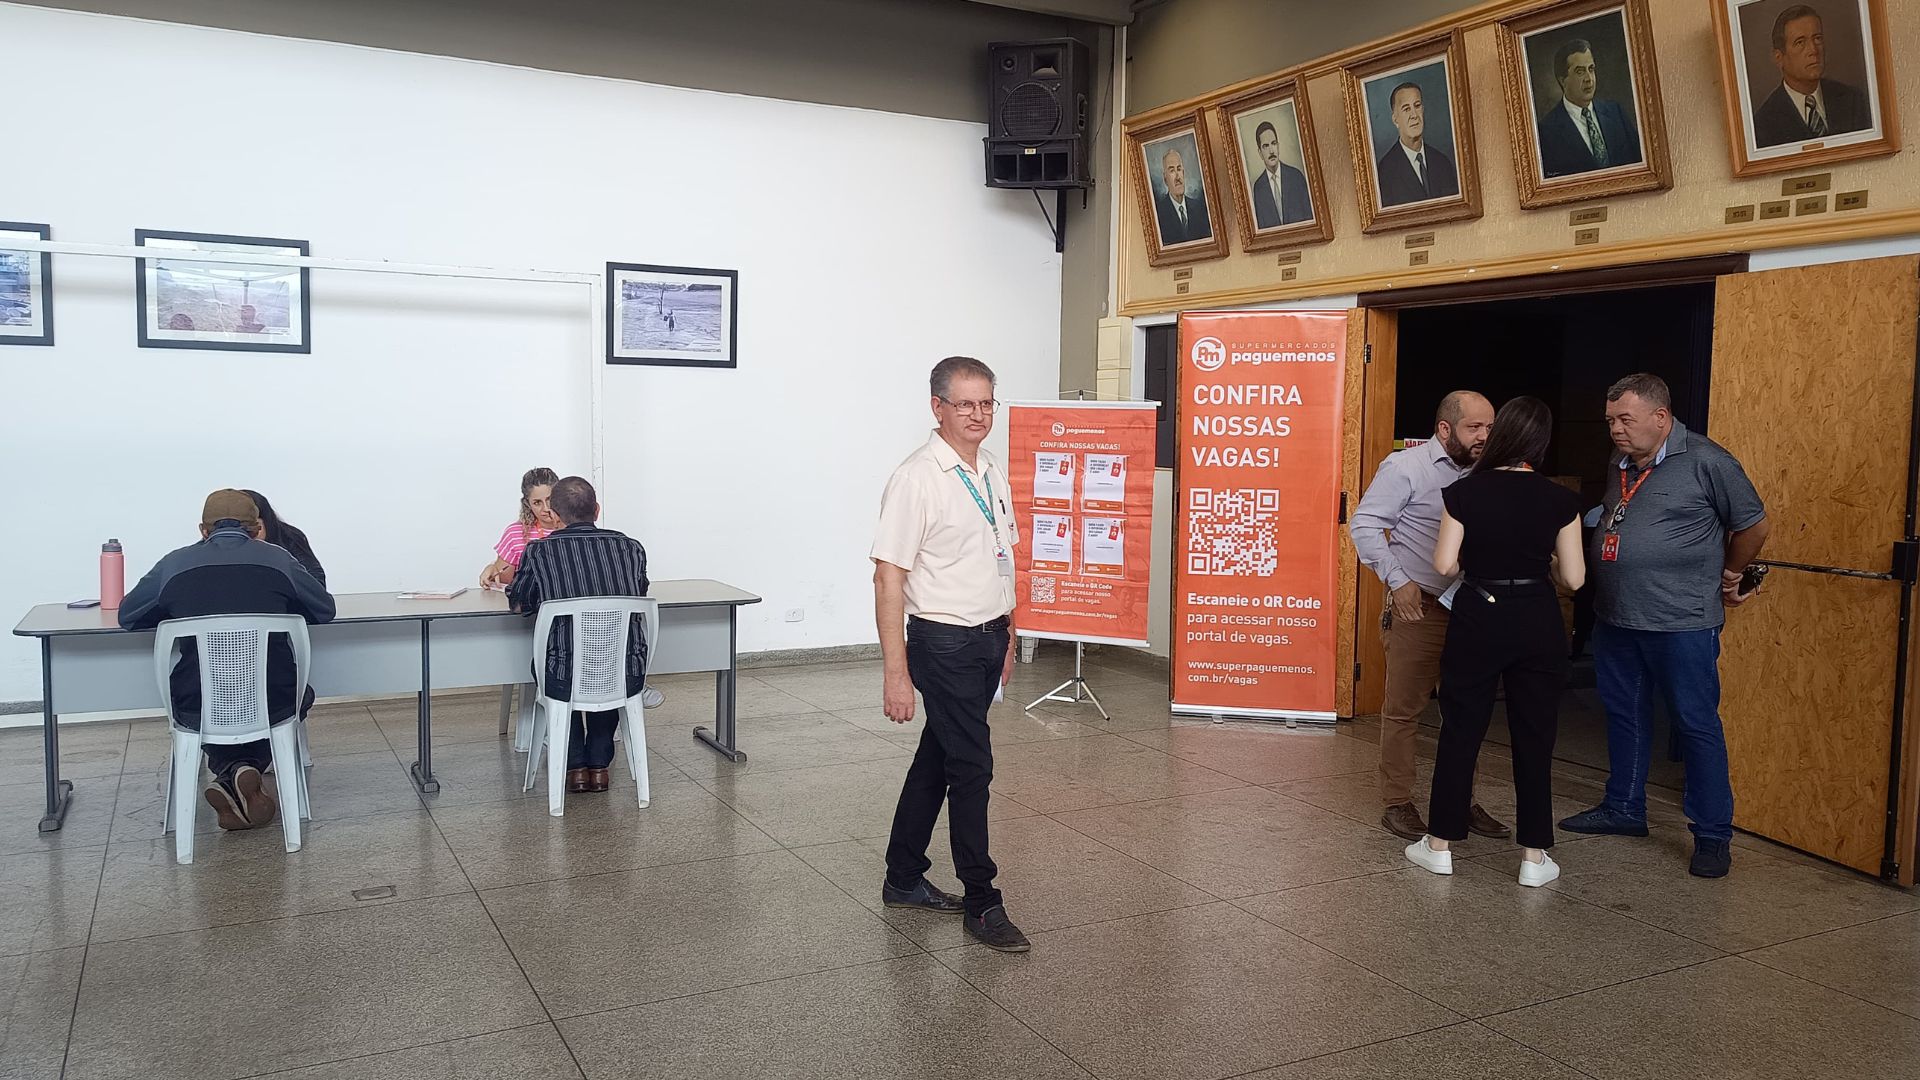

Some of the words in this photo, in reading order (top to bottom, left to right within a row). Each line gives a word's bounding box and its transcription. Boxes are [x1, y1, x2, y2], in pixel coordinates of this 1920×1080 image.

[1231, 352, 1336, 365] paguemenos
[1193, 384, 1303, 405] CONFIRA
[1192, 416, 1291, 437] NOSSAS
[1040, 441, 1068, 449] CONFIRA
[1069, 442, 1095, 450] NOSSAS
[1096, 443, 1121, 451] VAGAS!
[1191, 447, 1280, 468] VAGAS!
[1187, 592, 1249, 607] Escaneie
[1251, 597, 1261, 607] o
[1263, 595, 1283, 608] QR
[1286, 596, 1322, 610] Code
[1187, 613, 1217, 626] para
[1220, 614, 1274, 626] acessar
[1277, 616, 1317, 628] nosso
[1186, 630, 1226, 643] portal
[1230, 630, 1246, 643] de
[1250, 633, 1293, 647] vagas.
[1188, 661, 1316, 674] www.superpaguemenos.
[1188, 674, 1258, 686] com.br/vagas
